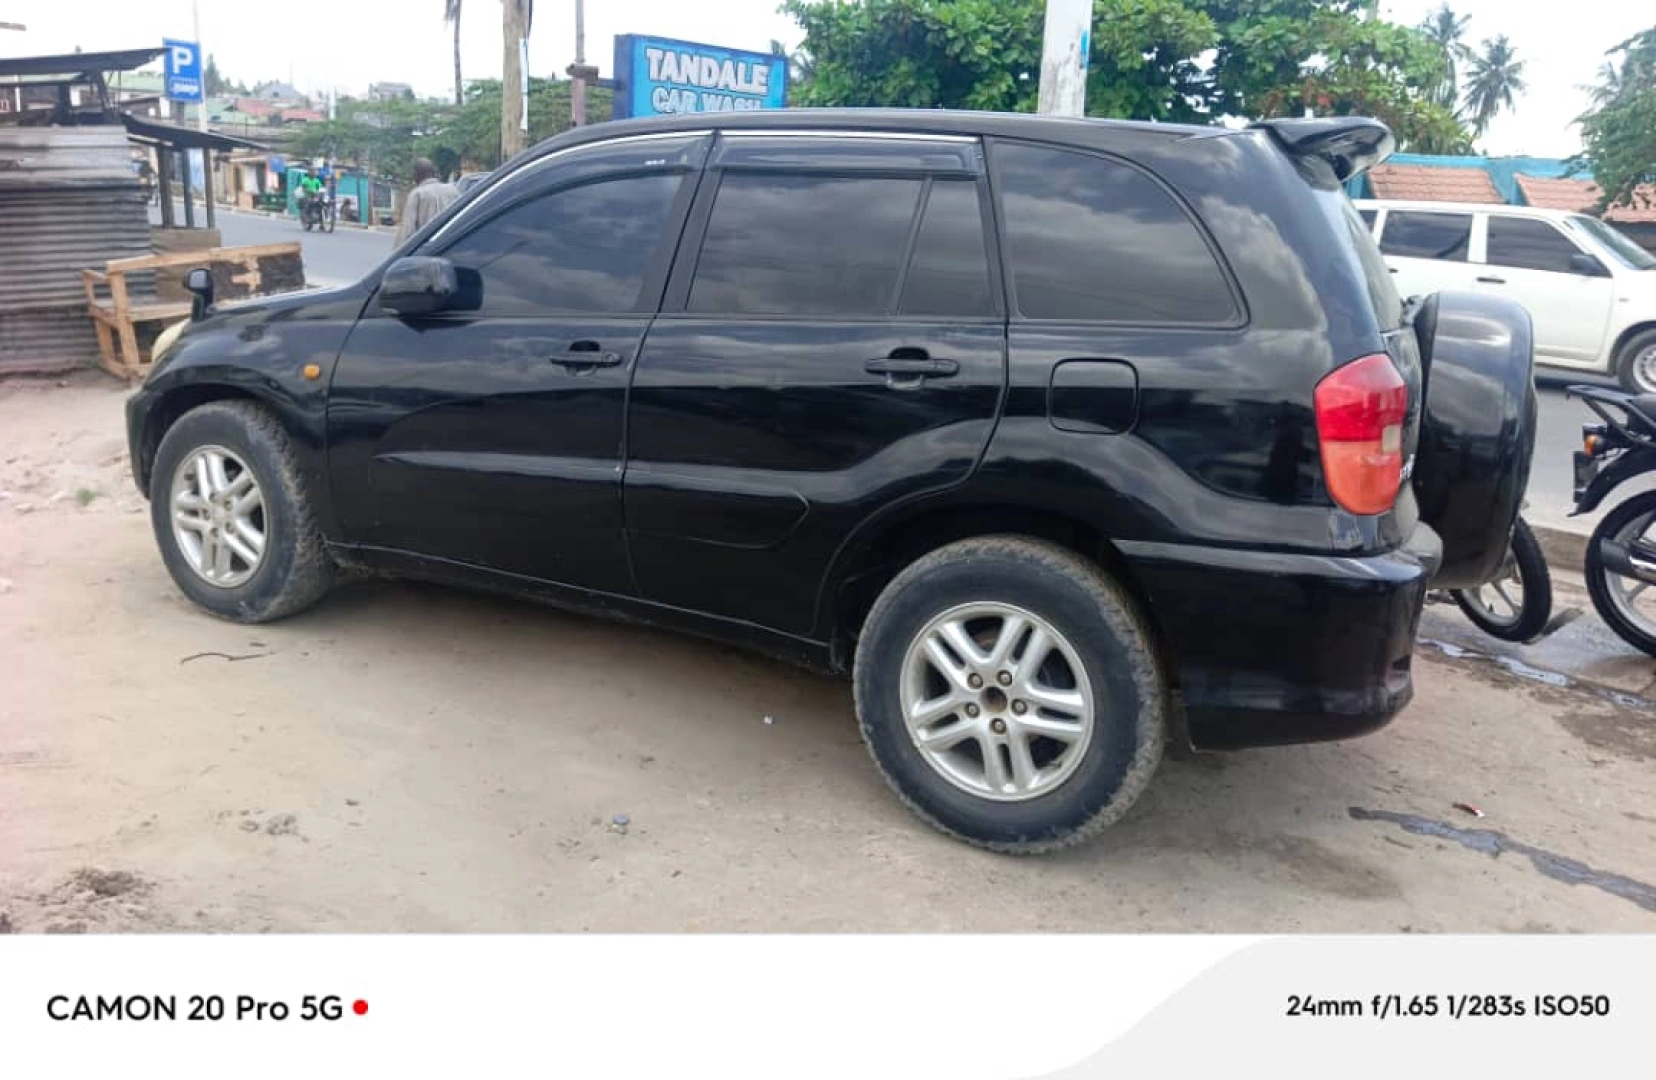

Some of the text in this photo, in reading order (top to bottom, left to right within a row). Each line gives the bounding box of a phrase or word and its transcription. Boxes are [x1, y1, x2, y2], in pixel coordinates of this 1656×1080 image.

[172, 46, 193, 75] P
[646, 48, 769, 95] TANDALE
[652, 87, 698, 113] CAR
